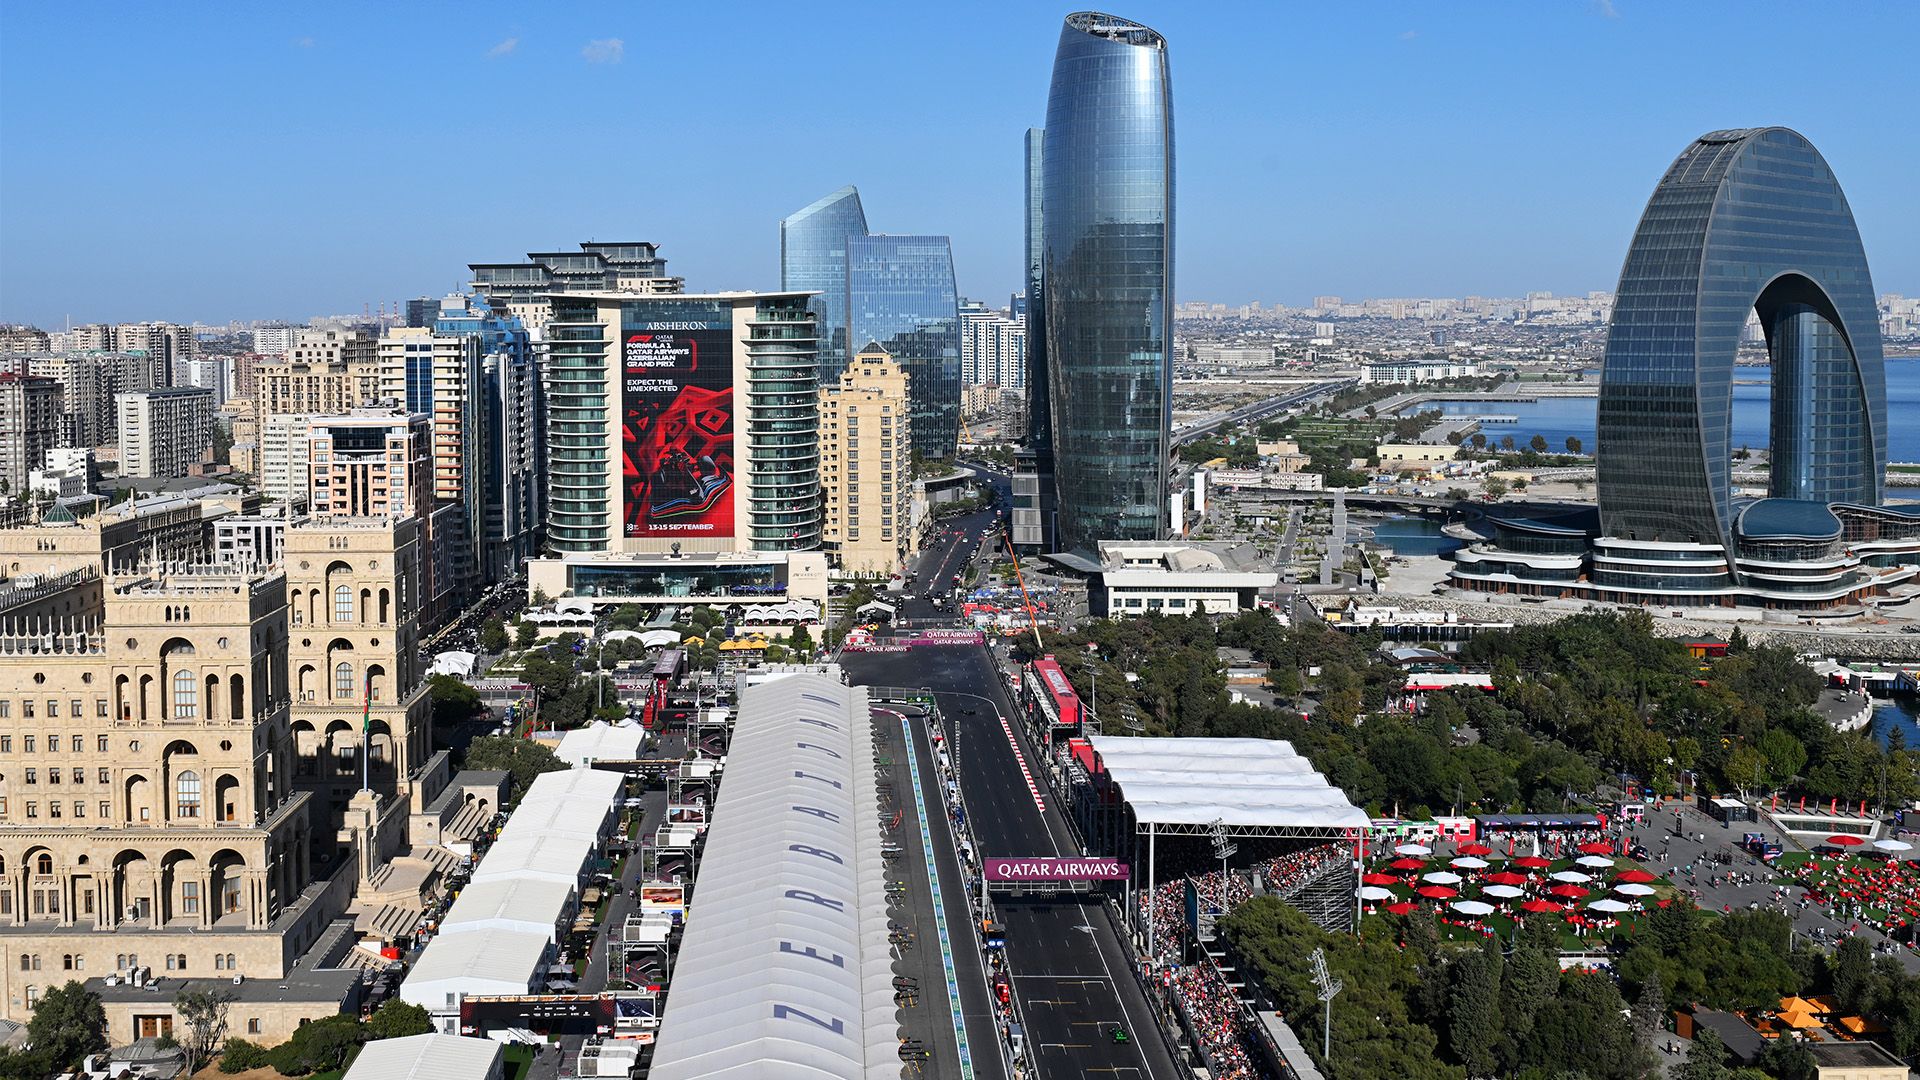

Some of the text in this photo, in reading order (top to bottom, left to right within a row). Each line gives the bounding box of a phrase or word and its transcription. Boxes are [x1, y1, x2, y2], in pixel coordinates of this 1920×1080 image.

[646, 321, 708, 330] ABSHERON
[998, 862, 1119, 878] QATAR AIRWAYS
